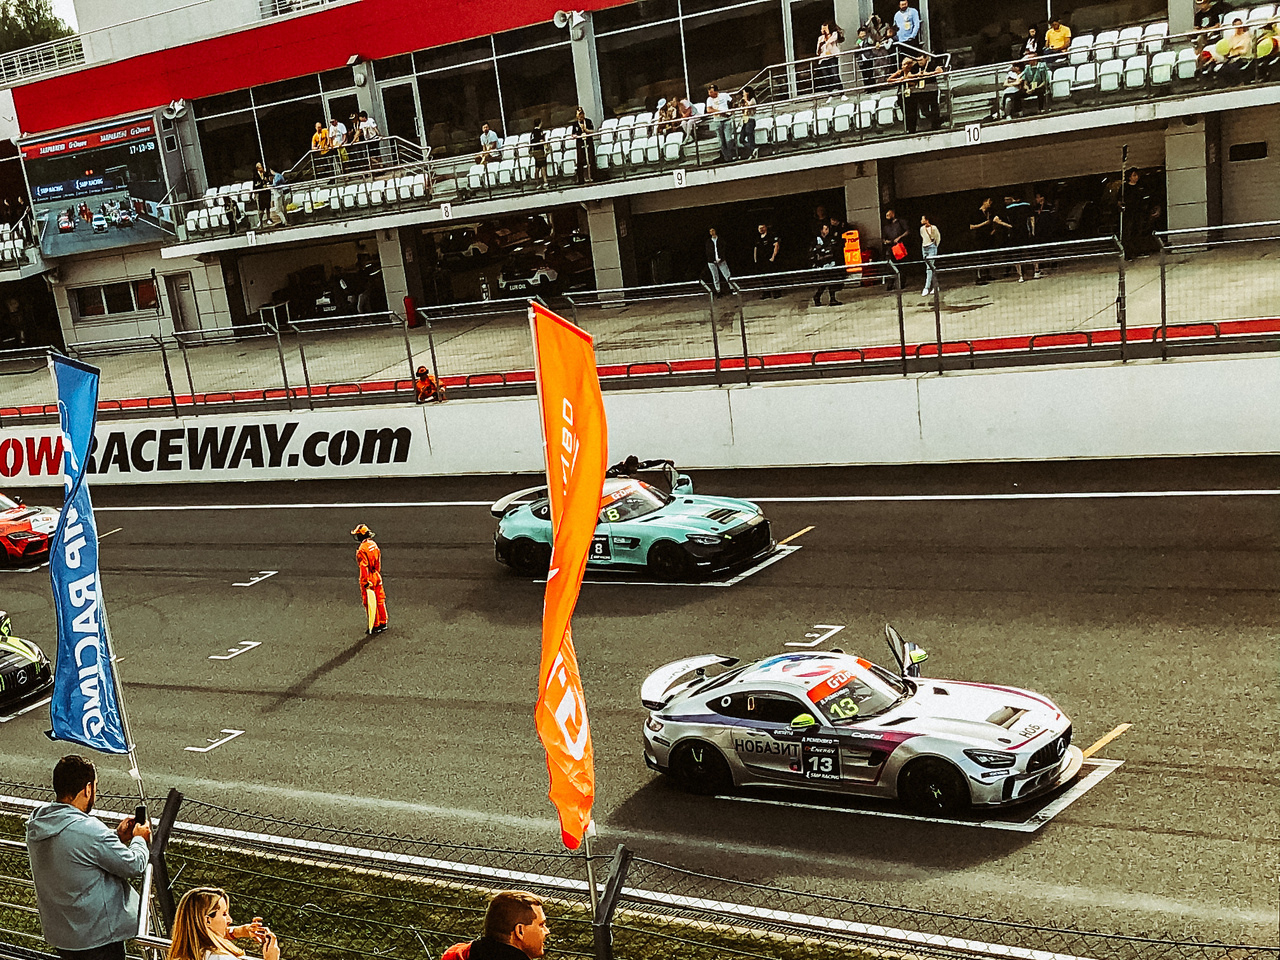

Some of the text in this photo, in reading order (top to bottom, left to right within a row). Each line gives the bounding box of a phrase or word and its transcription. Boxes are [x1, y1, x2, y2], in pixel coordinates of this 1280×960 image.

[966, 128, 981, 143] 10
[676, 173, 684, 186] 9
[443, 205, 450, 218] 8
[248, 232, 255, 244] 7
[607, 508, 620, 522] 8
[594, 543, 603, 554] 8
[829, 697, 860, 719] 13
[735, 738, 800, 758] НОБАЗИТ
[808, 756, 833, 772] 13
